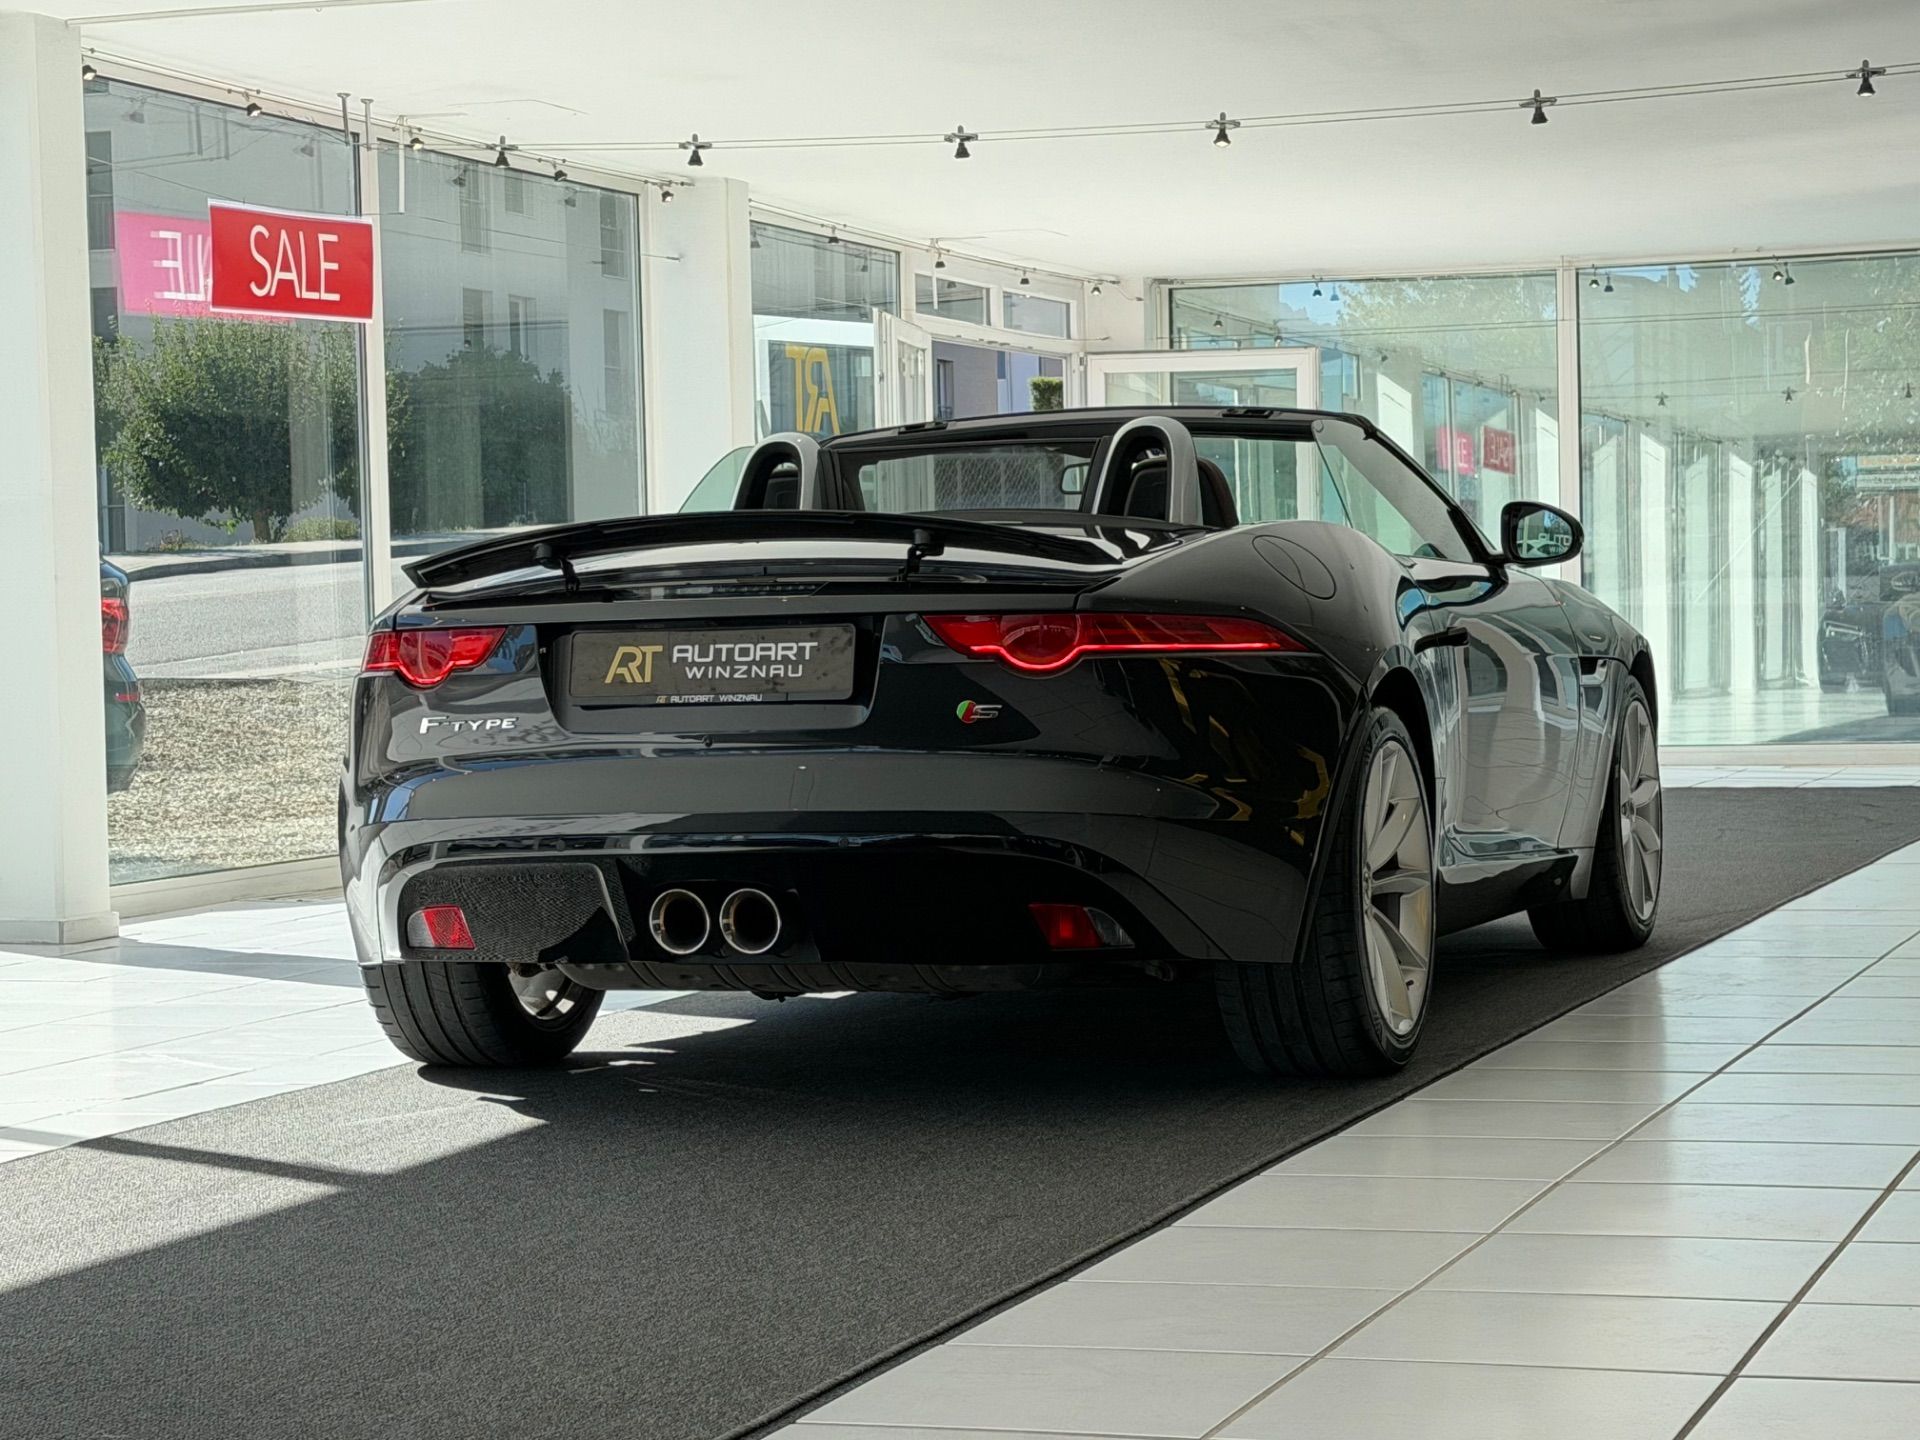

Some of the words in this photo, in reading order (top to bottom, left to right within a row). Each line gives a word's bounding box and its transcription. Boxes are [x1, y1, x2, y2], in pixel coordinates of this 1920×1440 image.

[249, 224, 341, 302] SALE
[672, 641, 819, 663] AUTOART
[685, 664, 803, 679] WINZNAU
[670, 694, 715, 703] AUTOART
[718, 693, 763, 702] WINZNAU
